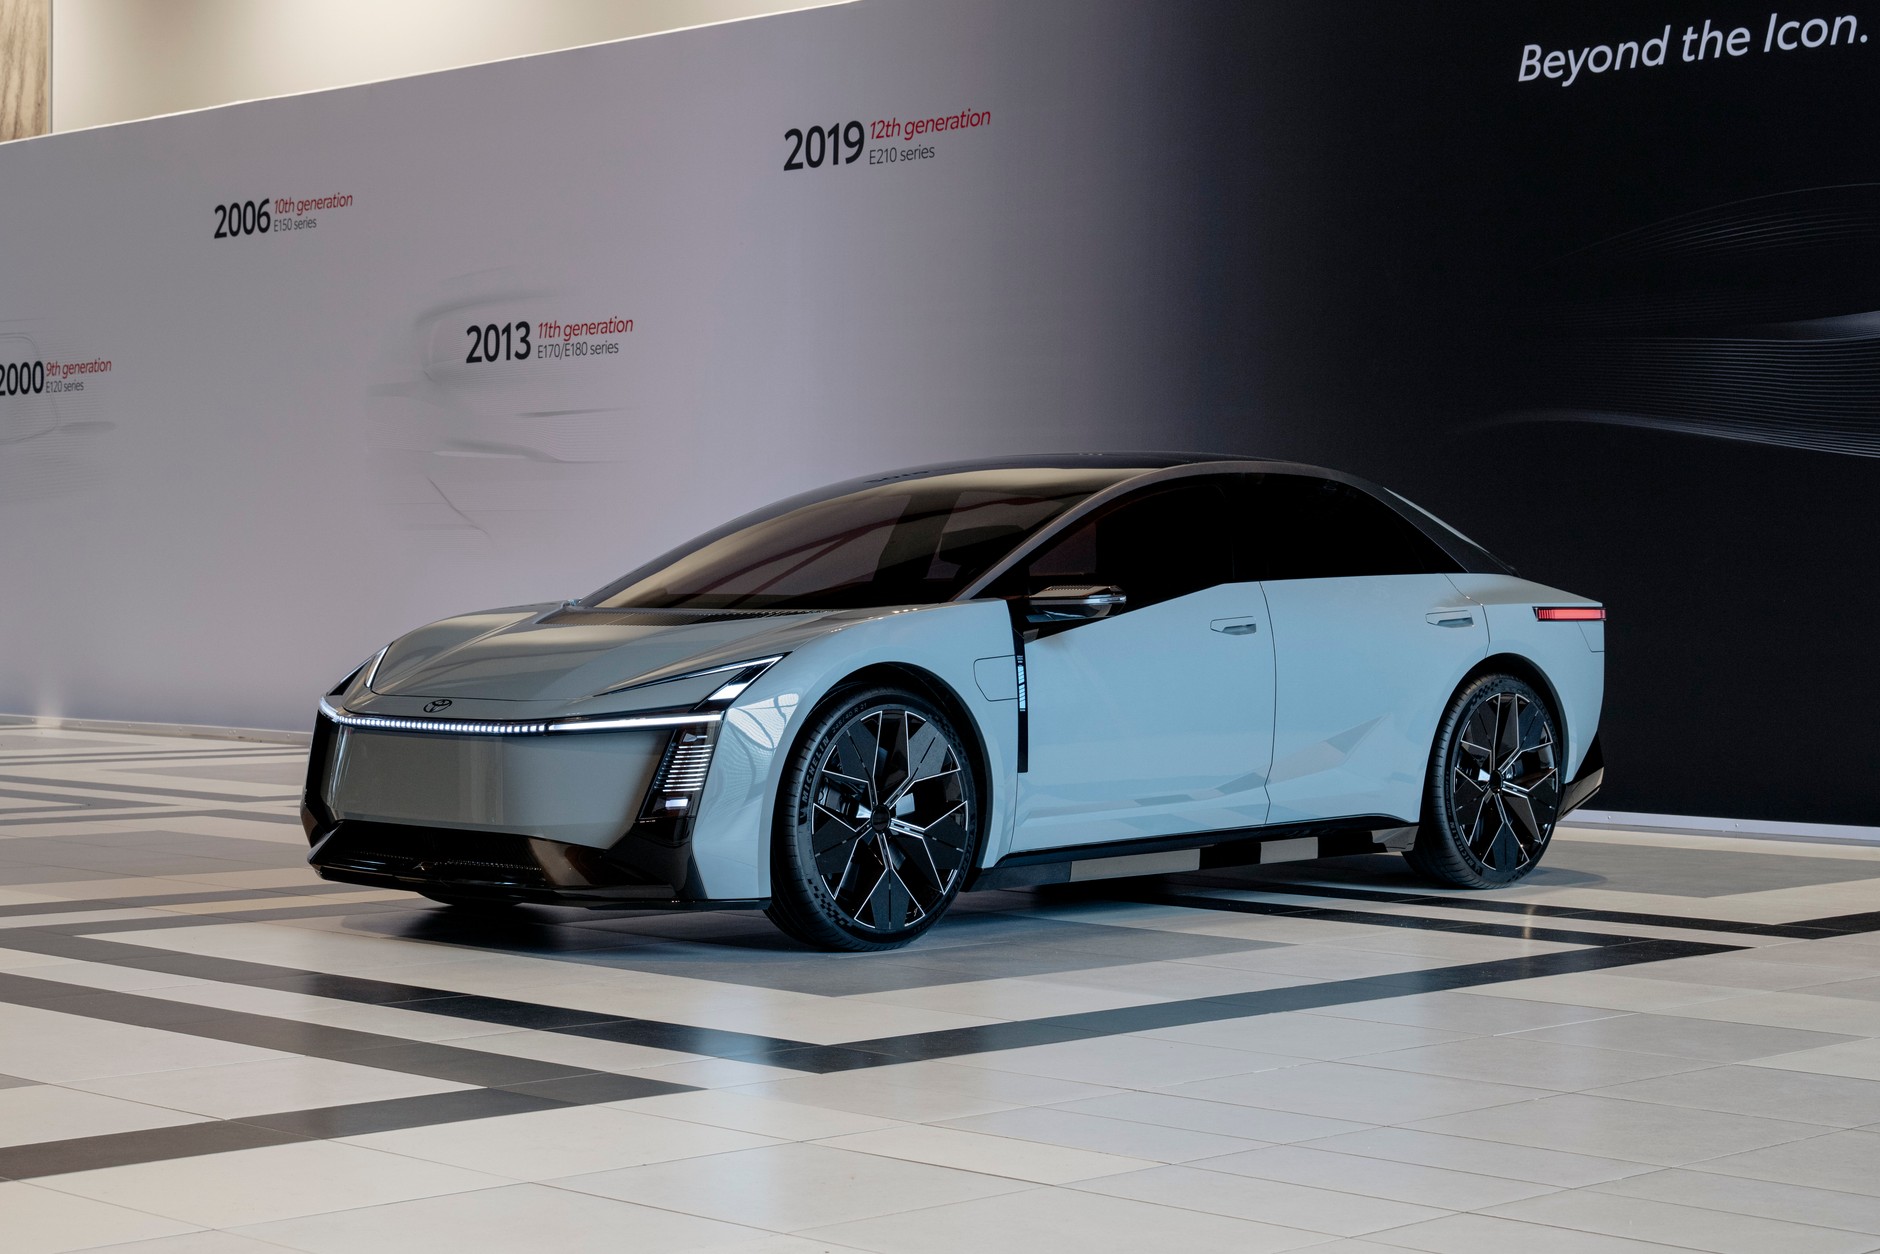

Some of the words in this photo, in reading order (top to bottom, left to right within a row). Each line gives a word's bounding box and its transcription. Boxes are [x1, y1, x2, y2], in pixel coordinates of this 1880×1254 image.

[1518, 25, 1671, 87] Beyond
[1683, 19, 1750, 62] the
[1764, 13, 1868, 53] Icon.
[870, 117, 901, 139] 12th
[904, 108, 991, 141] generation
[784, 120, 865, 171] 2019
[869, 146, 898, 165] E210
[900, 144, 936, 162] series
[213, 198, 271, 239] 2006
[275, 197, 295, 214] 10th
[296, 192, 353, 216] generation
[273, 218, 292, 233] E150
[293, 215, 317, 230] series
[465, 321, 532, 363] 2013
[538, 320, 561, 339] 11th
[563, 315, 634, 343] generation
[537, 341, 588, 360] E170/E180
[589, 340, 619, 356] series
[46, 361, 60, 377] 9th
[62, 358, 112, 379] generation
[45, 380, 62, 394] E120
[63, 379, 85, 392] series
[801, 735, 831, 803] MICHELIN
[1449, 821, 1475, 866] MICHELIN
